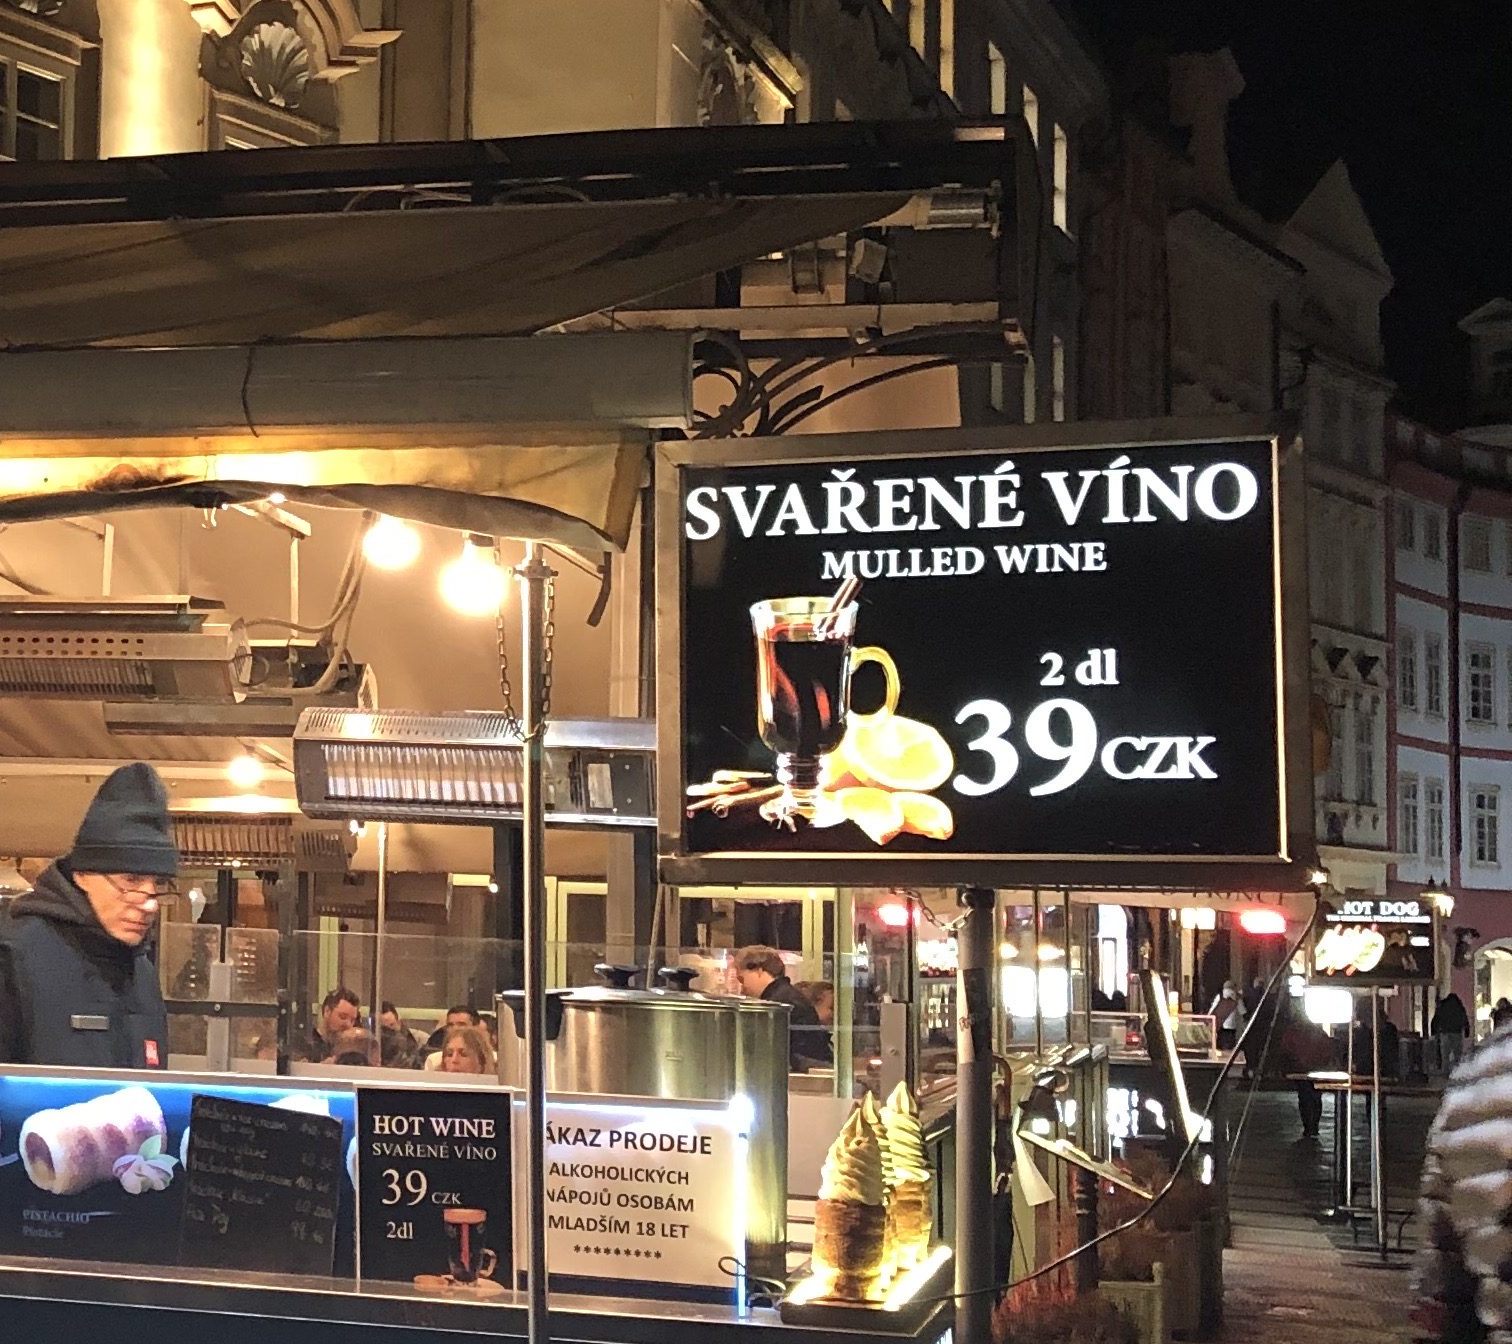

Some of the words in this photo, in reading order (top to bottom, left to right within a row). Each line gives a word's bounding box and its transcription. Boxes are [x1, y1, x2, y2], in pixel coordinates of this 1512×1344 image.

[684, 459, 1025, 540] SVAŘENÉ
[1041, 455, 1259, 526] VÍNO
[820, 544, 985, 580] MULLED
[994, 542, 1108, 574] WINE
[1040, 652, 1065, 686] 2
[1075, 648, 1119, 685] dl
[952, 698, 1098, 797] 39
[1101, 736, 1218, 780] CZK
[1380, 901, 1420, 916] DOG
[373, 1115, 424, 1136] HOT
[429, 1117, 496, 1138] WINE
[546, 1121, 602, 1147] ÁKAZ
[609, 1130, 713, 1155] PRODEJE
[372, 1141, 450, 1159] SVAŘENÉ
[454, 1142, 497, 1161] VÍNO
[549, 1162, 690, 1185] ALKOHOLICKÝCH
[381, 1168, 428, 1206] 39
[431, 1192, 463, 1205] CZK
[546, 1186, 612, 1206] NÁPOJŮ
[617, 1193, 694, 1212] OSOBÁM
[22, 1209, 90, 1224] PISTACHIO
[548, 1214, 630, 1234] MLADŠÍM
[637, 1222, 656, 1236] 18
[661, 1223, 690, 1238] LET
[386, 1221, 413, 1240] 2dl
